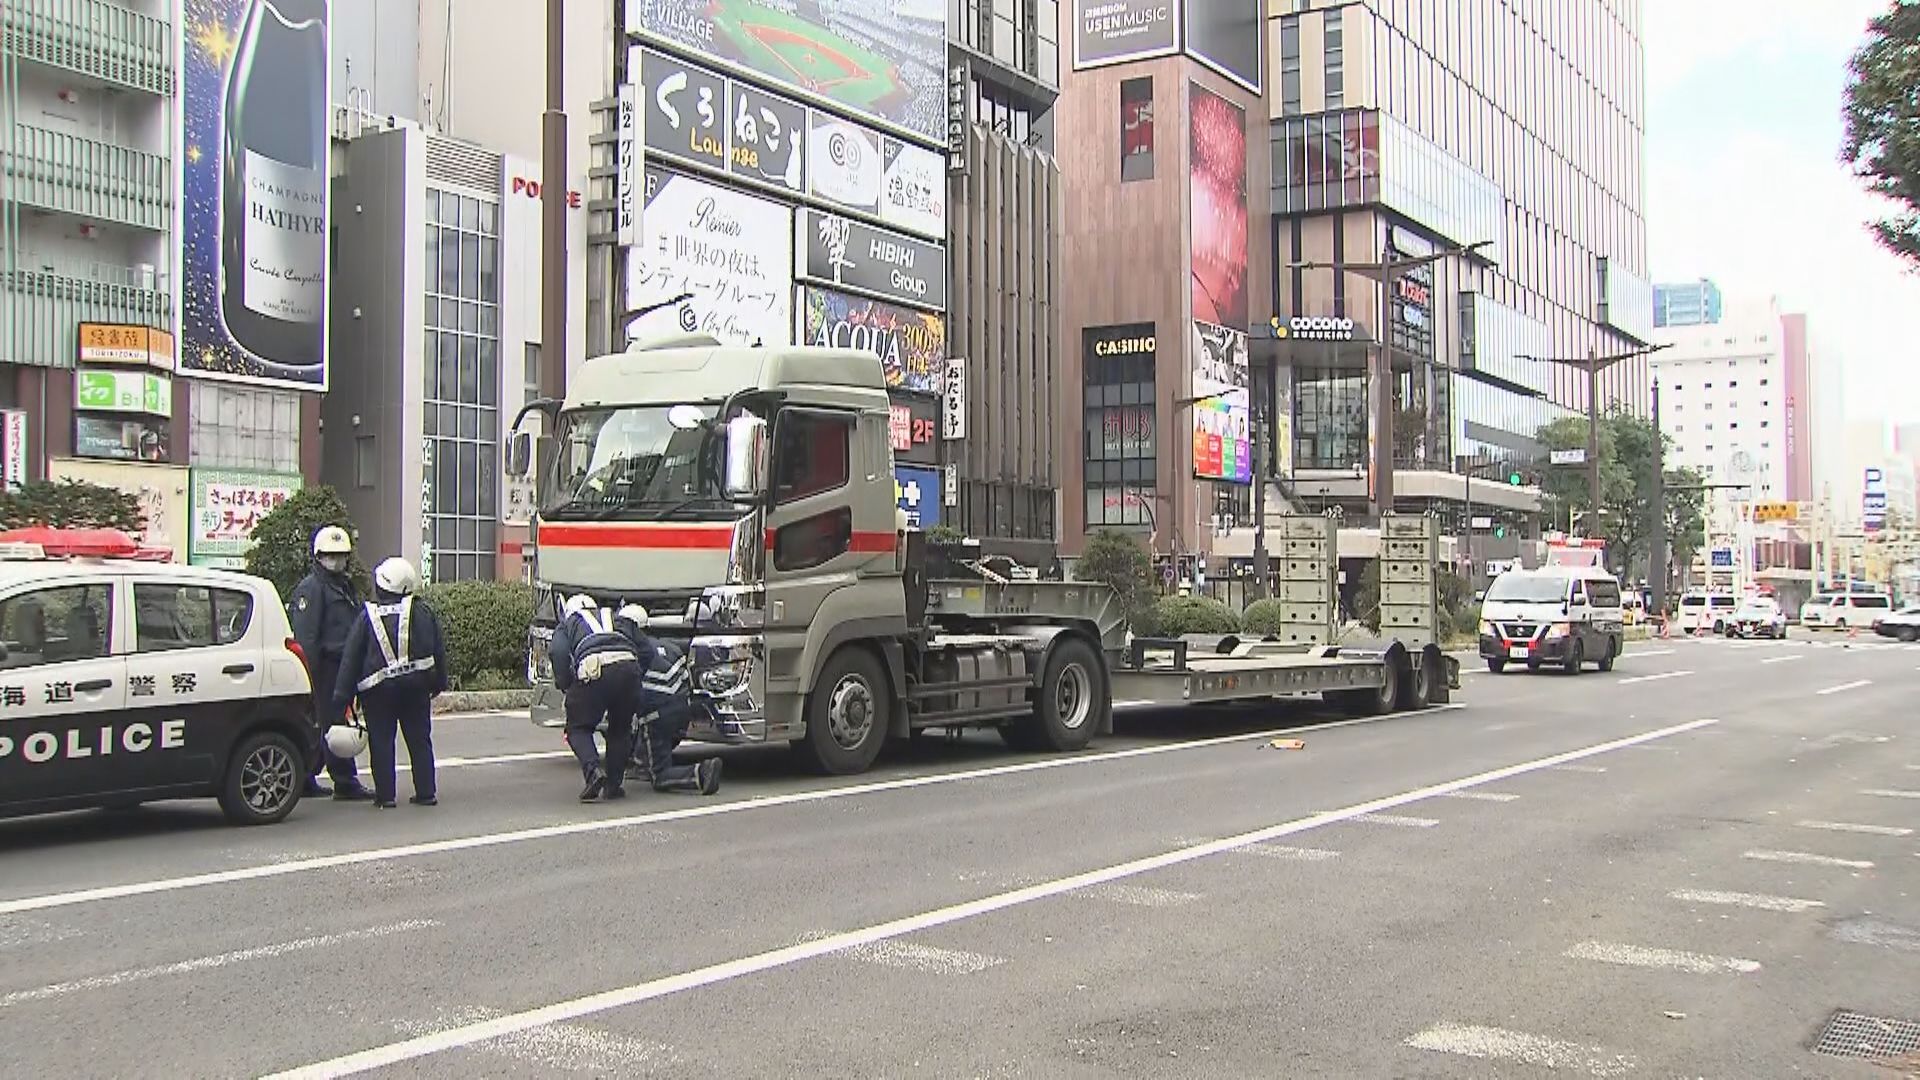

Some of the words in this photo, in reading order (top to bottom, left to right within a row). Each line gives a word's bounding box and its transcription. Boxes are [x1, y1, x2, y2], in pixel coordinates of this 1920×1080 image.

[657, 4, 713, 42] VILLAGE
[1084, 16, 1121, 34] USEN
[1123, 6, 1167, 27] MUSIC
[1102, 25, 1149, 39] Entertainment
[656, 71, 781, 152] くろねこ
[690, 127, 759, 168] Lounge
[869, 239, 916, 269] HIBIKI
[890, 268, 928, 298] Group
[1095, 336, 1156, 357] CASINO
[913, 418, 935, 444] 2F
[1864, 468, 1883, 491] P
